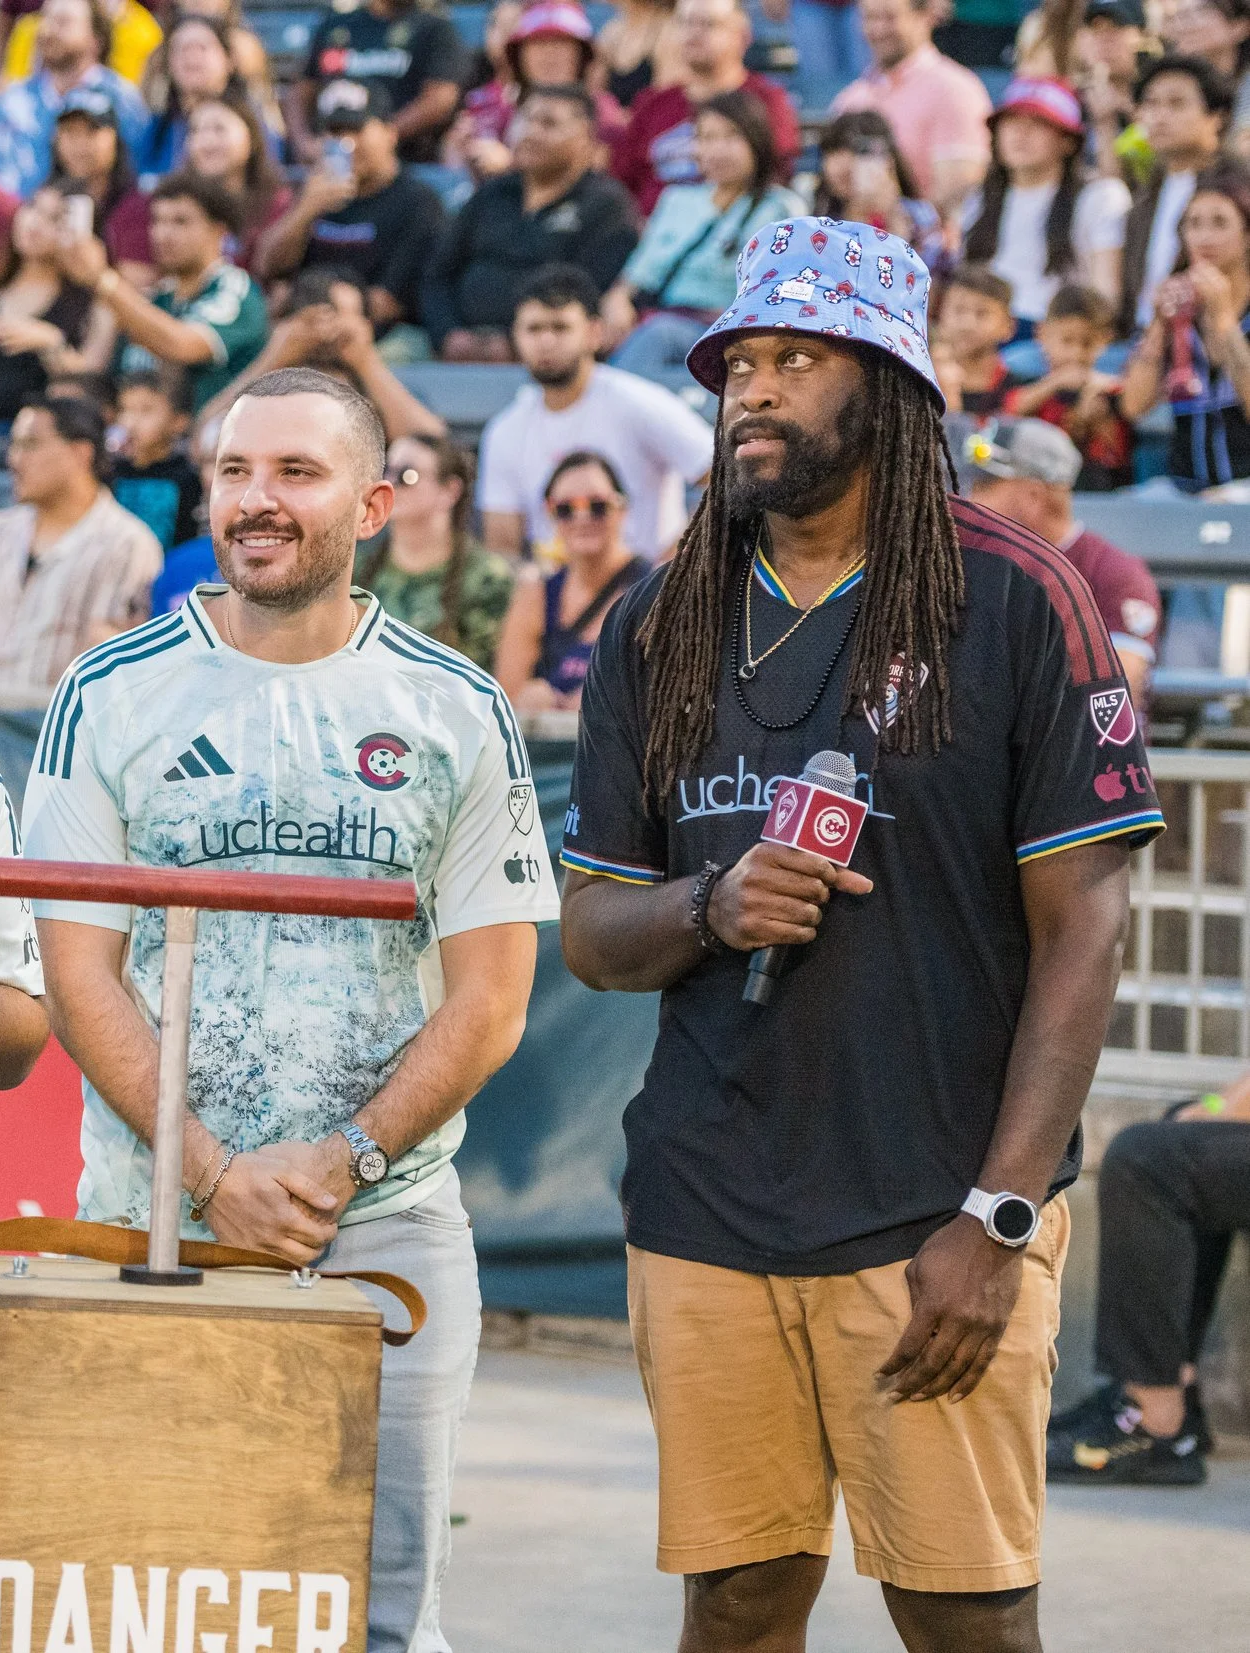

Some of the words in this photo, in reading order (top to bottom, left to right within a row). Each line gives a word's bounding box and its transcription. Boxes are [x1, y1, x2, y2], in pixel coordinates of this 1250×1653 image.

[1093, 694, 1119, 710] MLS
[510, 788, 527, 800] MLS
[200, 800, 396, 864] uchealth
